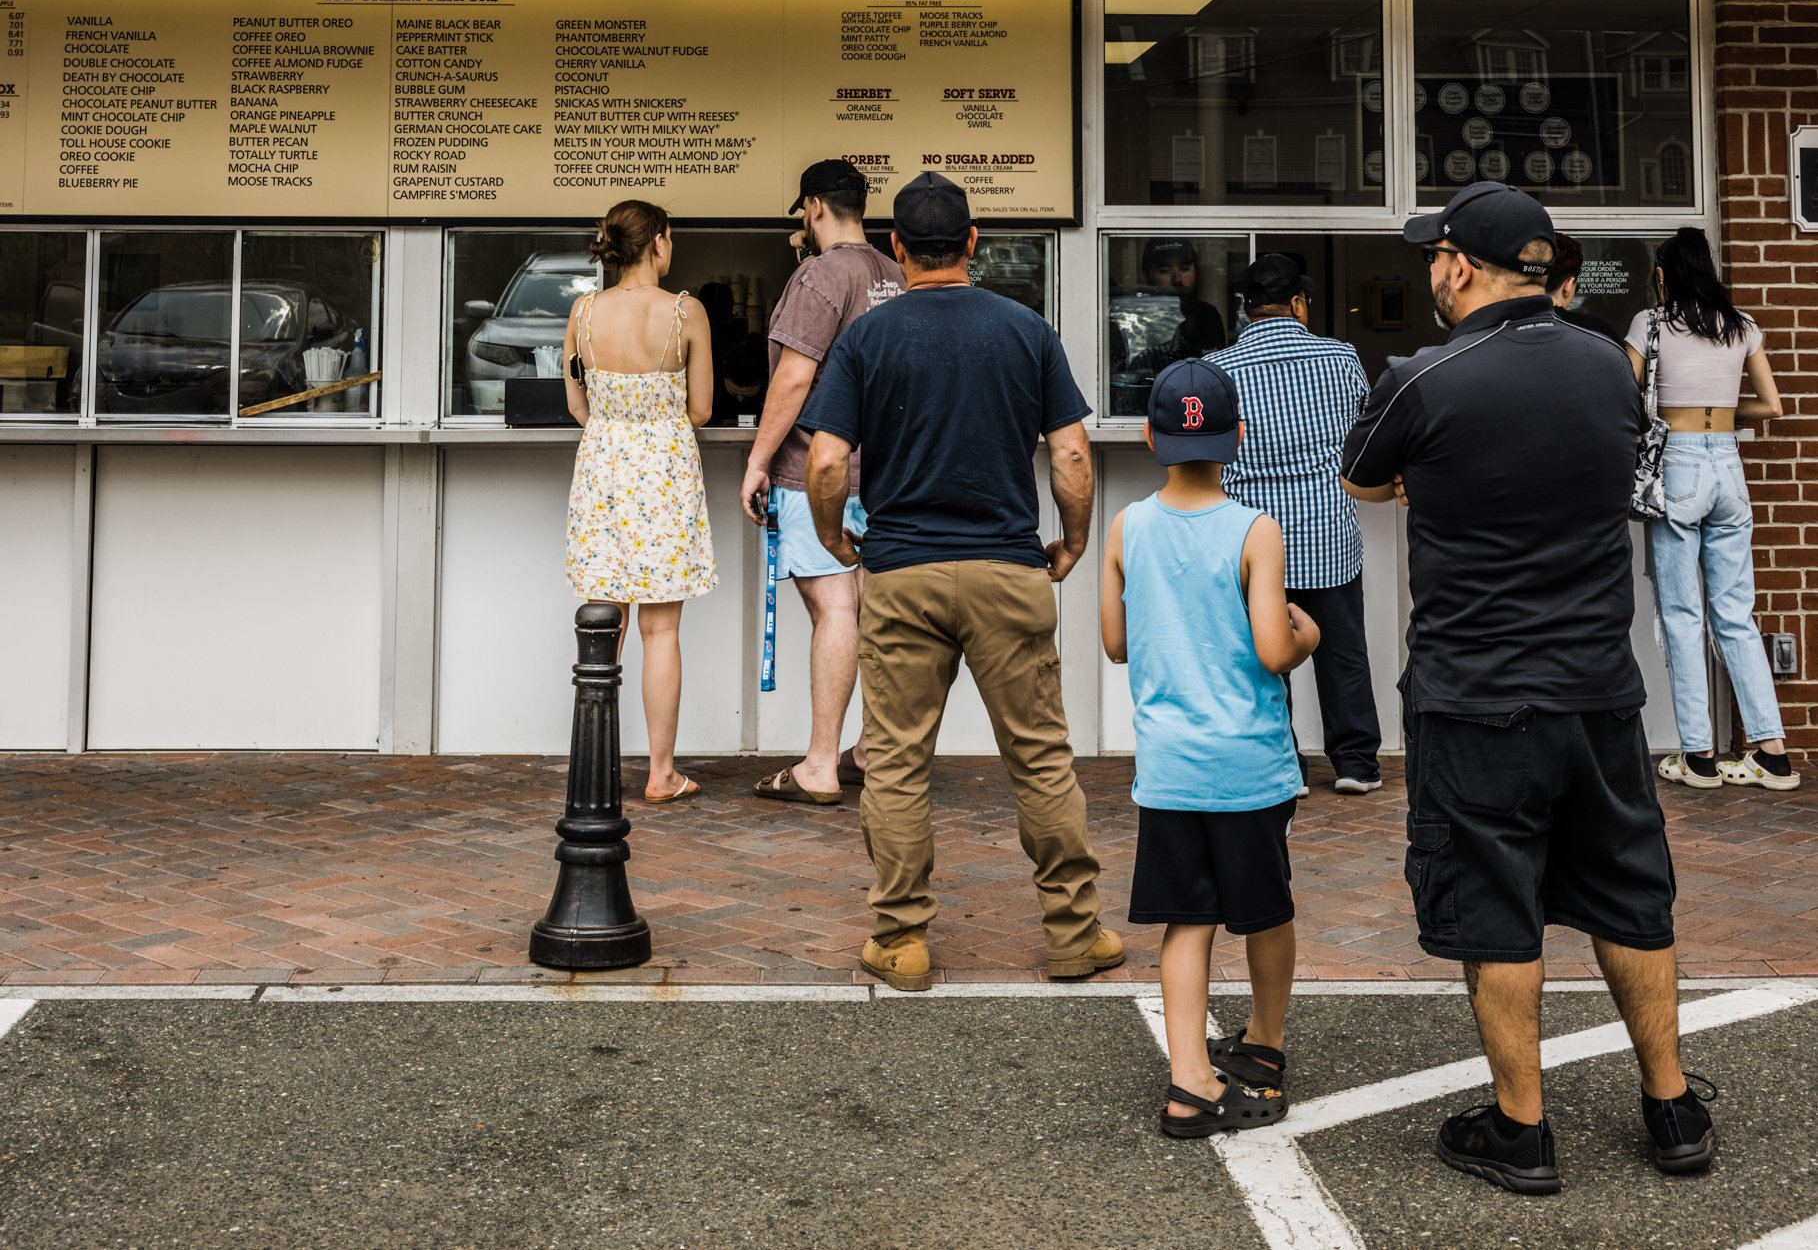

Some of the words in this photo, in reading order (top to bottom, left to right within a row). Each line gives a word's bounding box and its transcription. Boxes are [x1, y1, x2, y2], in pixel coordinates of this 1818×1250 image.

[9, 12, 24, 20] 6.07
[842, 12, 871, 20] COFFEE
[873, 12, 902, 20] TOFFEE
[67, 17, 113, 26] VANILLA
[234, 18, 276, 27] PEANUT
[279, 18, 319, 27] BUTTER
[322, 18, 353, 28] OREO
[397, 20, 432, 28] MAINE
[436, 20, 470, 29] BLACK
[473, 20, 500, 29] BEAR
[556, 20, 591, 29] GREEN
[595, 20, 646, 29] MONSTER
[8, 30, 23, 38] 8.41
[66, 31, 107, 40] FRENCH
[111, 31, 156, 40] VANILLA
[233, 32, 272, 41] COFFEE
[275, 32, 305, 42] OREO
[396, 33, 462, 42] PEPPERMINT
[465, 33, 493, 42] STICK
[556, 33, 645, 42] PHANTOMBERRY
[970, 30, 1007, 38] ALMOND
[64, 44, 129, 53] CHOCOLATE
[233, 45, 271, 54] COFFEE
[275, 46, 320, 54] KAHLUA
[324, 46, 374, 55] BROWNIE
[396, 46, 424, 55] CAKE
[428, 46, 467, 55] BATTER
[556, 46, 619, 55] CHOCOLATE
[622, 46, 670, 55] WALNUT
[673, 46, 708, 56] FUDGE
[64, 58, 107, 67] DOUBLE
[110, 58, 175, 68] CHOCOLATE
[232, 58, 271, 67] COFFEE
[274, 58, 324, 68] ALMOND
[327, 59, 362, 68] FUDGE
[396, 59, 440, 68] COTTON
[444, 59, 482, 68] CANDY
[556, 59, 597, 68] CHERRY
[600, 60, 645, 68] VANILLA
[63, 72, 98, 82] DEATH
[102, 73, 116, 82] BY
[120, 73, 184, 82] CHOCOLATE
[232, 71, 304, 80] STRAWBERRY
[396, 72, 498, 81] CRUNCH-A-SAURUS
[555, 72, 609, 82] COCONUT
[63, 86, 127, 95] CHOCOLATE
[131, 86, 155, 95] CHIP
[231, 84, 266, 94] BLACK
[269, 85, 330, 94] RASPBERRY
[395, 85, 435, 94] BUBBLE
[438, 85, 465, 94] GUM
[555, 86, 609, 94] PISTACHIO
[837, 89, 892, 98] SHERBET
[944, 89, 974, 98] SOFT
[978, 89, 1015, 98] SERVE
[62, 99, 127, 108] CHOCOLATE
[131, 100, 174, 108] PEANUT
[177, 100, 217, 109] BUTTER
[231, 98, 278, 106] BANANA
[395, 98, 467, 107] STRAWBERRY
[470, 98, 537, 107] CHEESECAKE
[847, 104, 882, 112] ORANGE
[62, 112, 90, 121] MINT
[92, 112, 157, 122] CHOCOLATE
[161, 113, 185, 122] CHIP
[230, 111, 276, 120] ORANGE
[280, 111, 335, 120] PINEAPPLE
[395, 111, 434, 120] BUTTER
[438, 112, 482, 120] CRUNCH
[61, 125, 102, 134] COOKIE
[106, 126, 147, 135] DOUGH
[230, 124, 266, 133] MAPLE
[269, 124, 317, 133] WALNUT
[394, 124, 442, 133] GERMAN
[446, 124, 510, 134] CHOCOLATE
[513, 125, 542, 134] CAKE
[60, 138, 86, 148] TOLL
[90, 139, 126, 148] HOUSE
[130, 139, 170, 148] COOKIE
[230, 137, 269, 146] BUTTER
[273, 138, 308, 146] PECAN
[394, 138, 435, 146] FROZEN
[439, 138, 488, 147] PUDDING
[60, 152, 91, 161] OREO
[94, 152, 135, 161] COOKIE
[230, 150, 276, 159] TOTALLY
[279, 151, 317, 160] TURTLE
[394, 151, 431, 160] ROCKY
[434, 151, 466, 160] ROAD
[922, 154, 942, 164] NO
[946, 154, 988, 164] SUGAR
[991, 155, 1034, 164] ADDED
[841, 155, 890, 165] SORBET
[60, 165, 98, 174] COFFEE
[229, 164, 271, 172] MOCHA
[274, 164, 298, 173] CHIP
[394, 164, 418, 173] RUM
[422, 164, 456, 173] RAISIN
[59, 178, 120, 187] BLUEBERRY
[123, 179, 138, 188] PIE
[228, 177, 268, 186] MOOSE
[271, 177, 312, 186] TRACKS
[394, 177, 452, 186] GRAPENUT
[455, 177, 504, 186] CUSTARD
[554, 177, 607, 186] COCONUT
[610, 178, 665, 186] PINEAPPLE
[393, 190, 446, 199] CAMPFIRE
[450, 190, 496, 199] S'MORES
[1182, 396, 1204, 429] B
